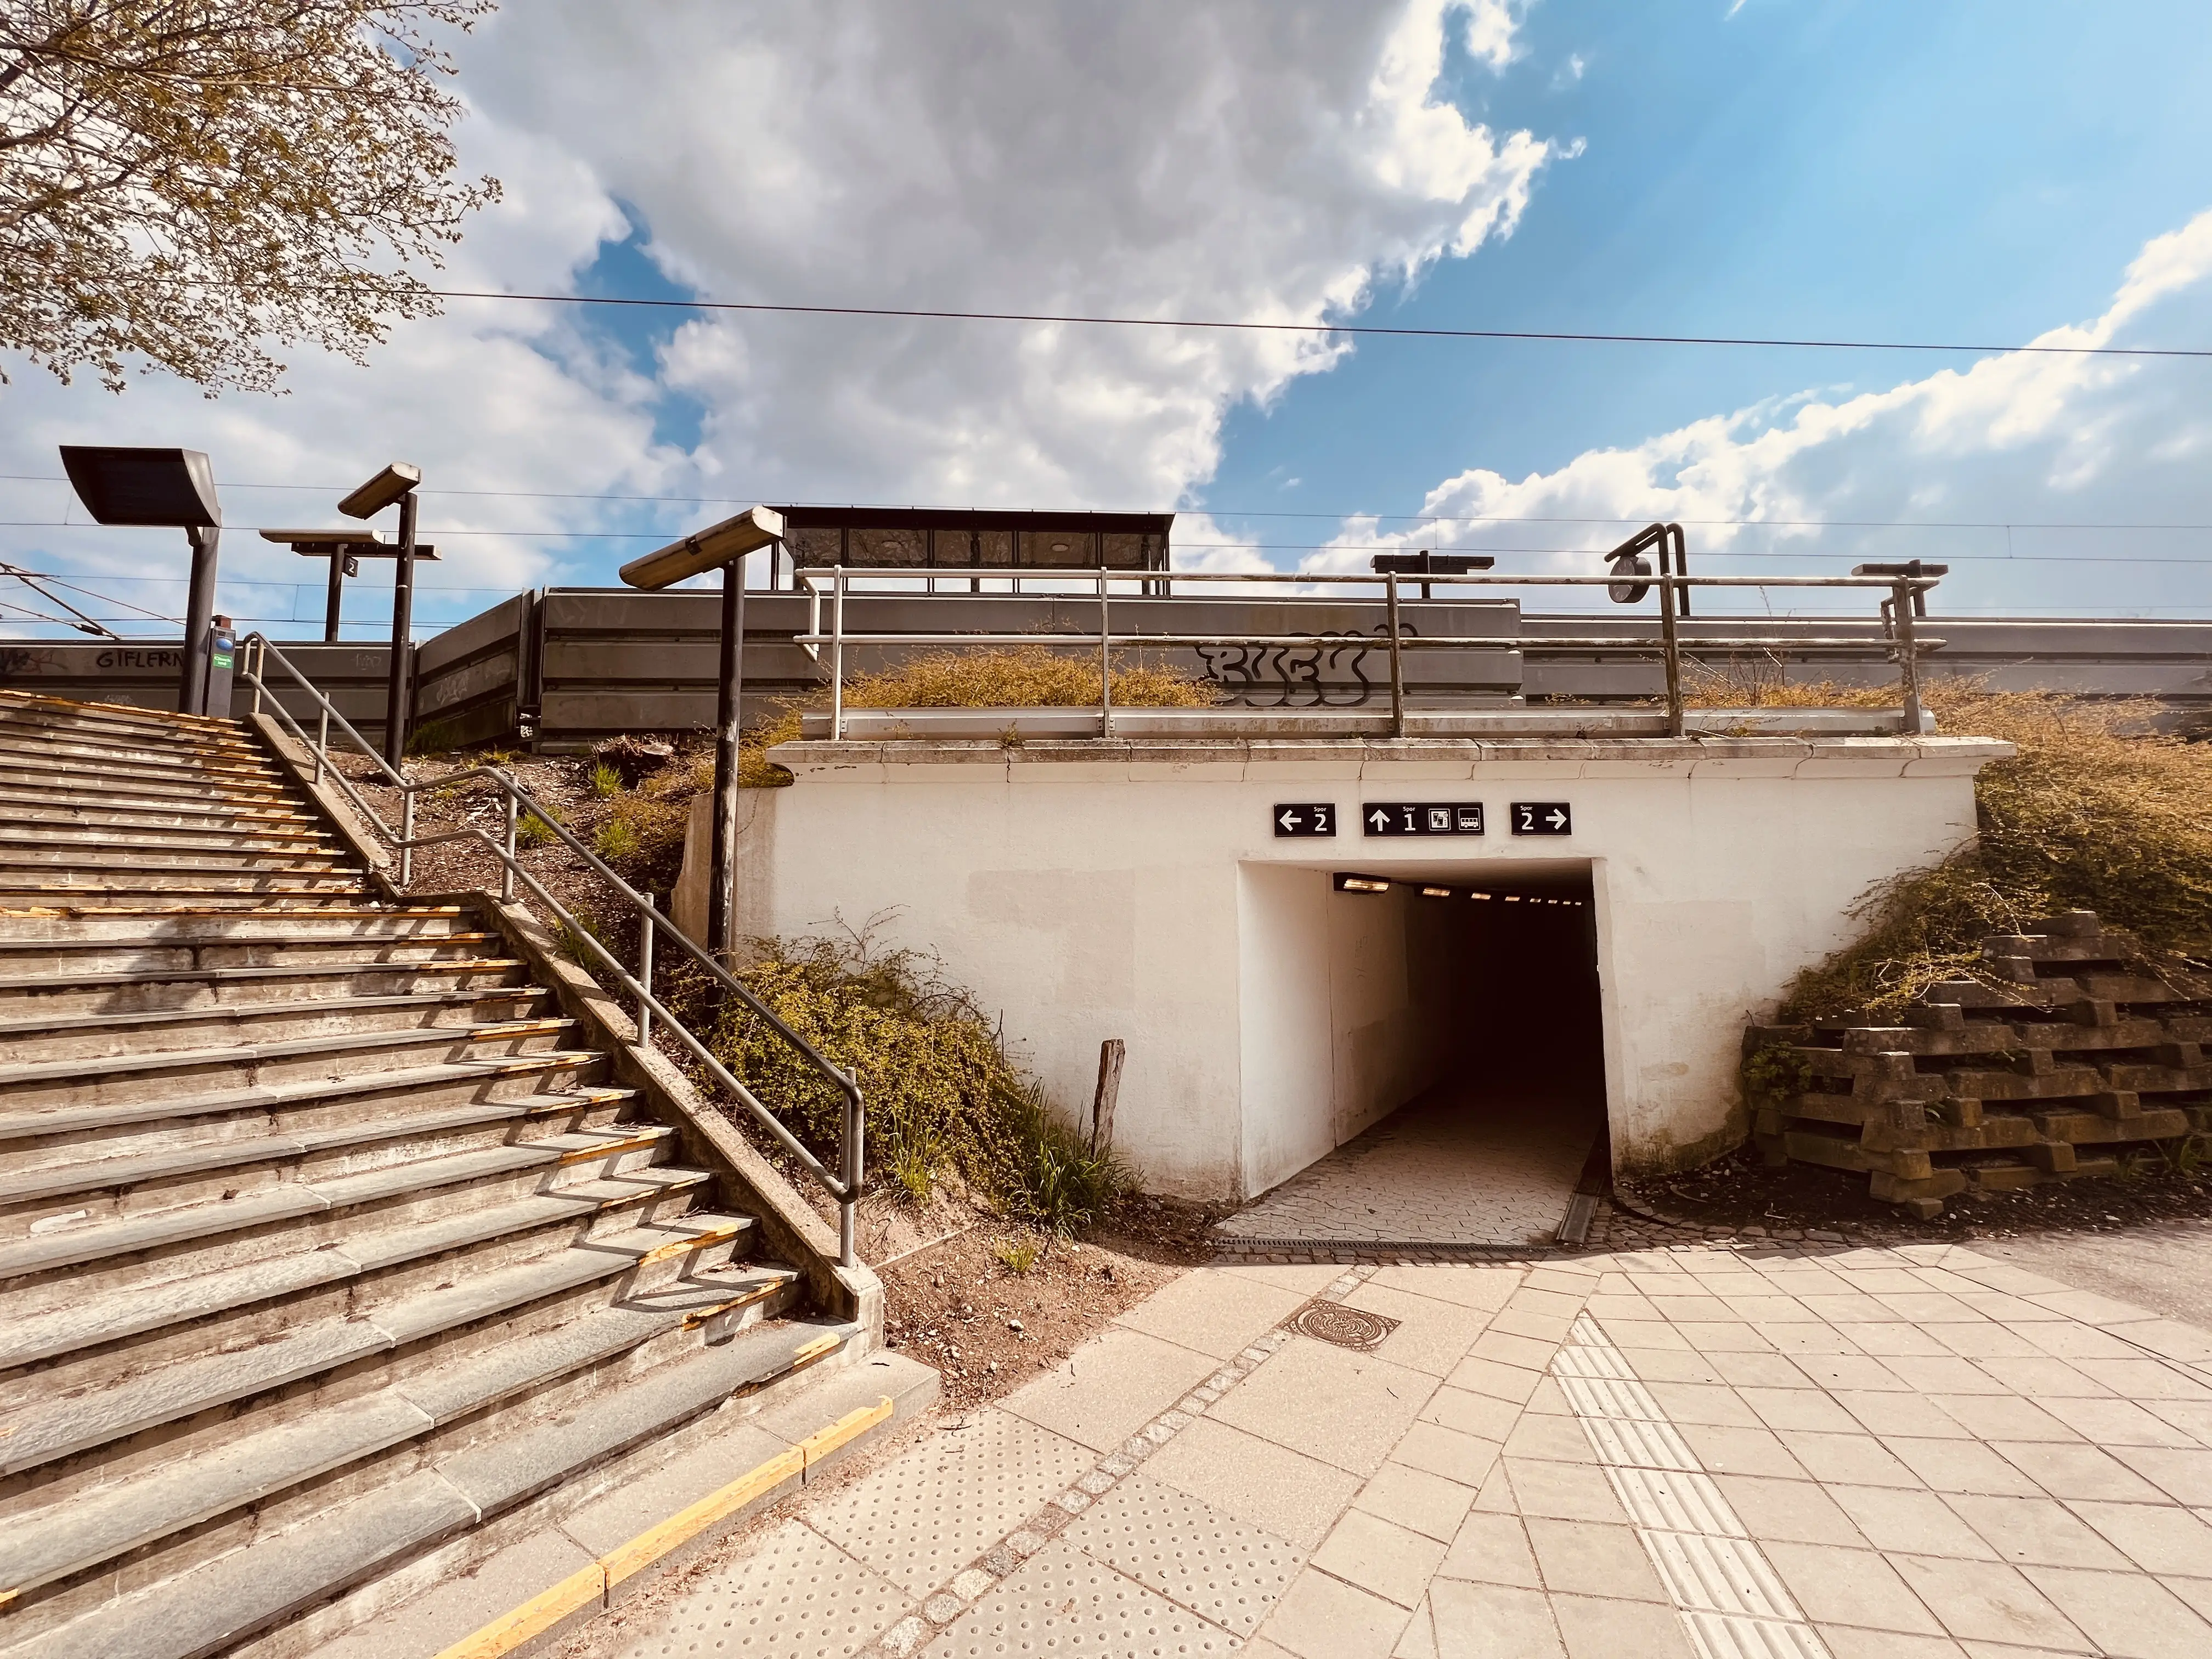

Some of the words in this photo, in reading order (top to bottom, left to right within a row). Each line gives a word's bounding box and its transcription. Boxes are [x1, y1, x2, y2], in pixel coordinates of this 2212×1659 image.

[349, 562, 354, 573] 2
[1314, 814, 1327, 831] 2
[1404, 813, 1416, 831] 1
[1521, 812, 1534, 830] 2
